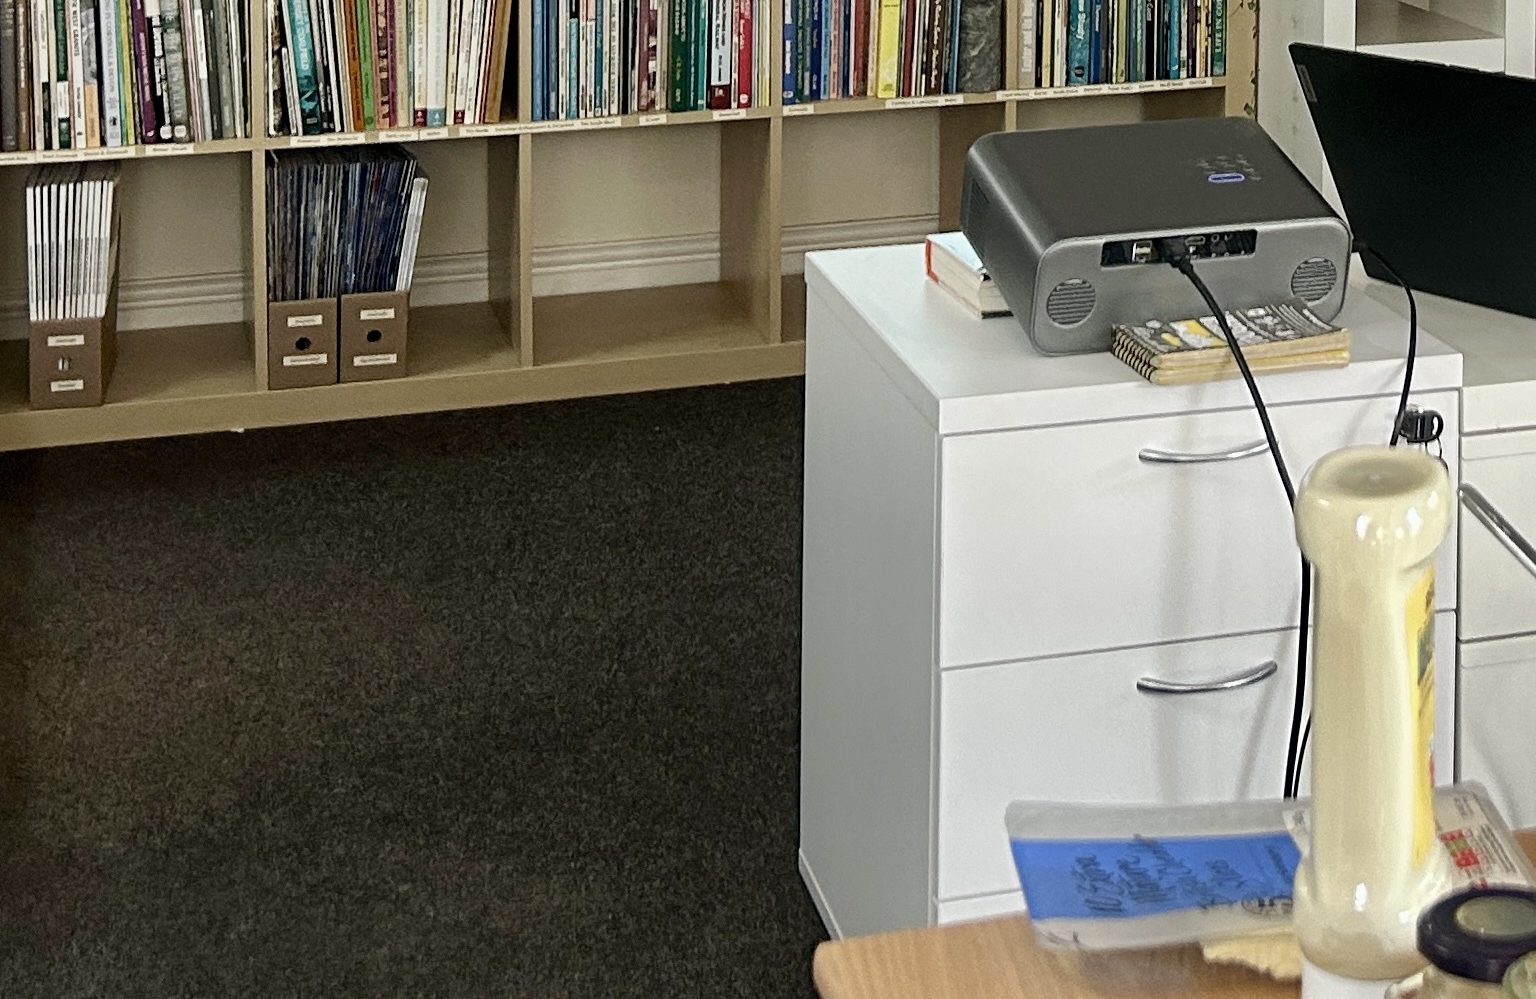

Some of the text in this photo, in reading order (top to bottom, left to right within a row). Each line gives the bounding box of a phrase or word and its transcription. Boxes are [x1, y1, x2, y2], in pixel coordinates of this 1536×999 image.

[1075, 12, 1086, 40] Study
[1215, 18, 1223, 30] IN
[1215, 31, 1223, 53] LIFE
